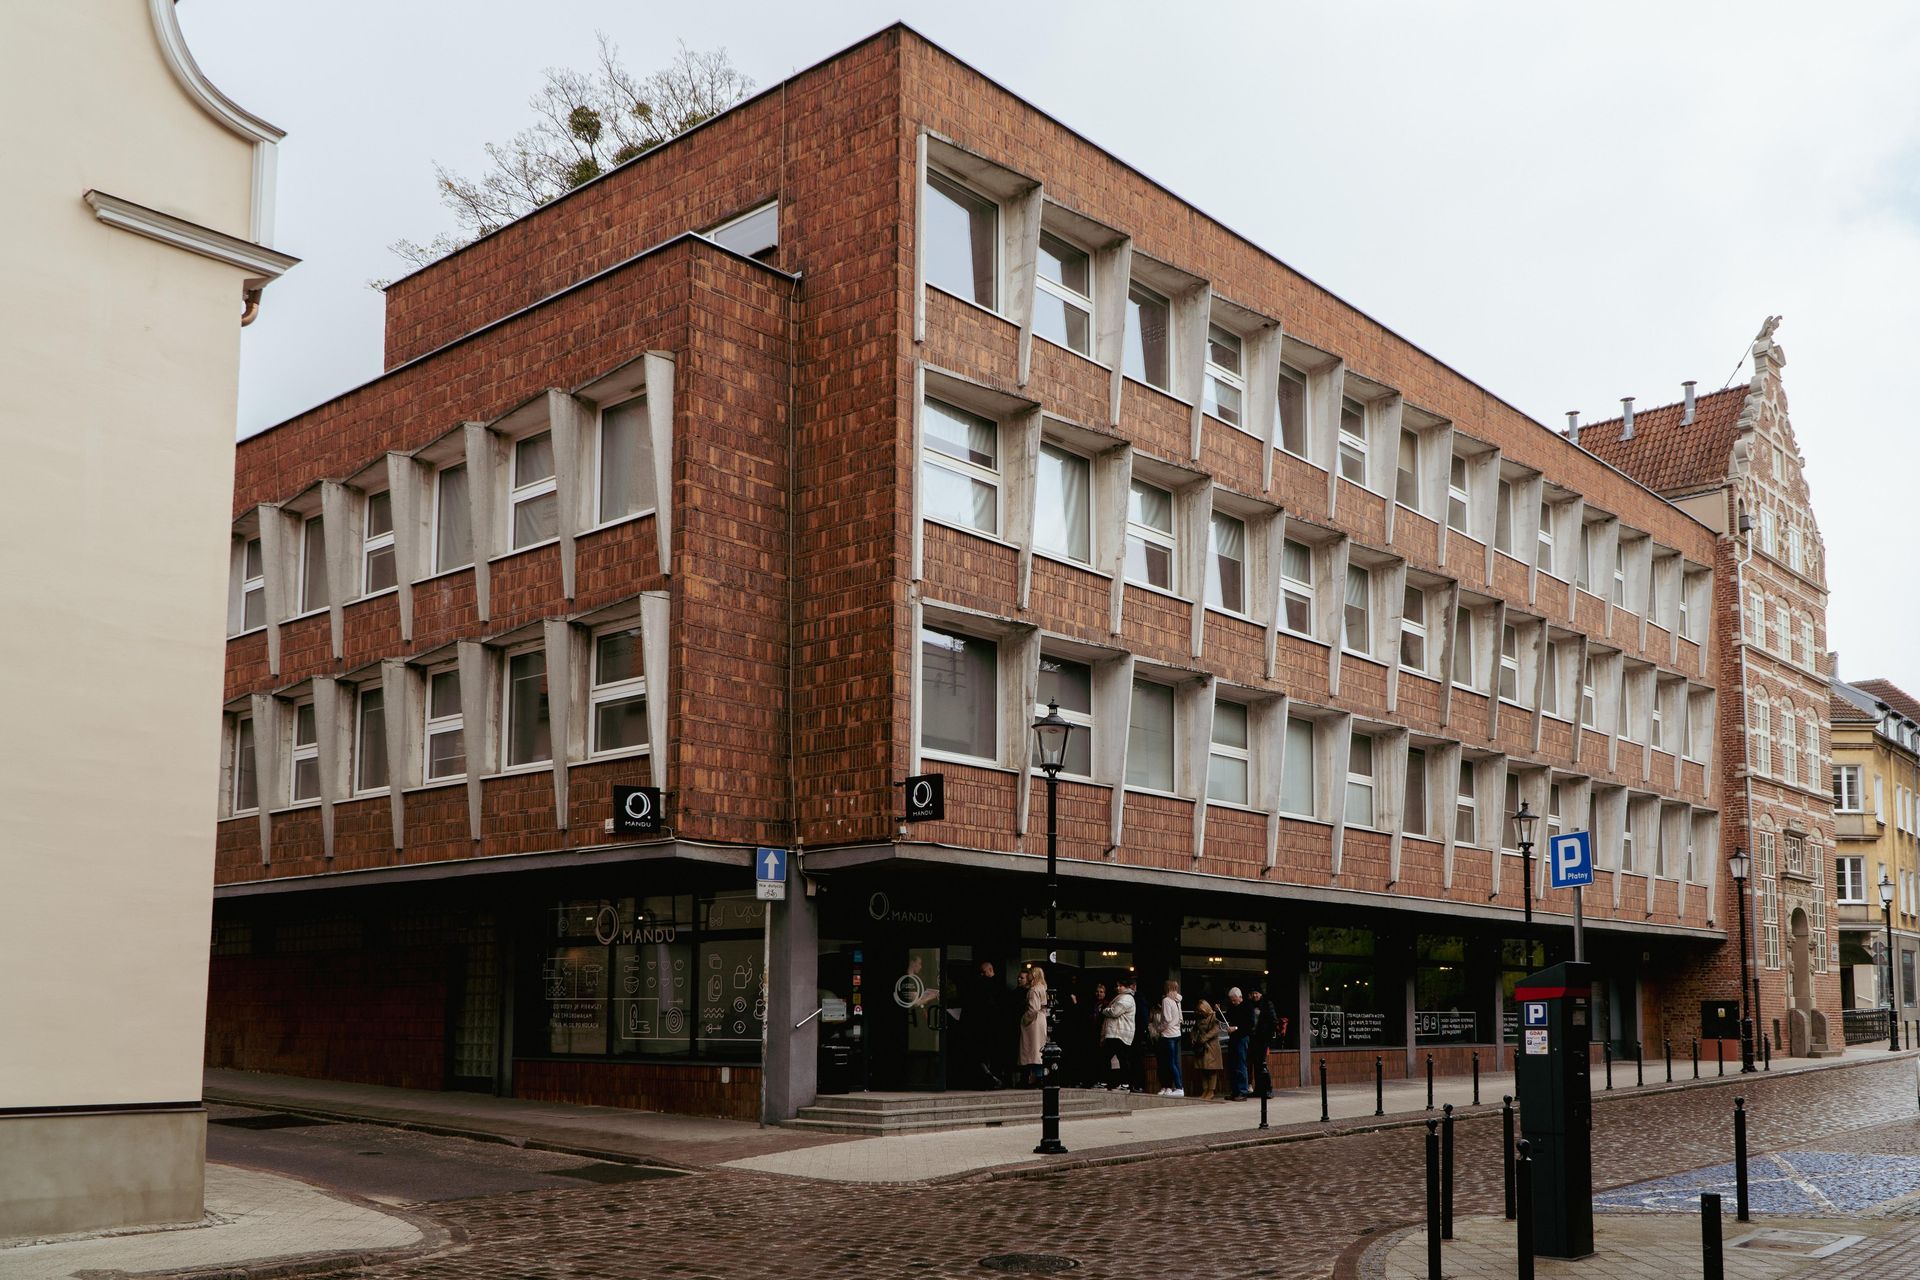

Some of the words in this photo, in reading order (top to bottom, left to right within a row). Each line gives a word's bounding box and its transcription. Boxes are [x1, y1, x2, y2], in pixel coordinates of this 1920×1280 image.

[624, 820, 652, 828] MANDU
[1557, 837, 1582, 881] P
[891, 911, 933, 923] MANDU
[622, 927, 676, 945] MANDU
[1528, 1004, 1544, 1024] P
